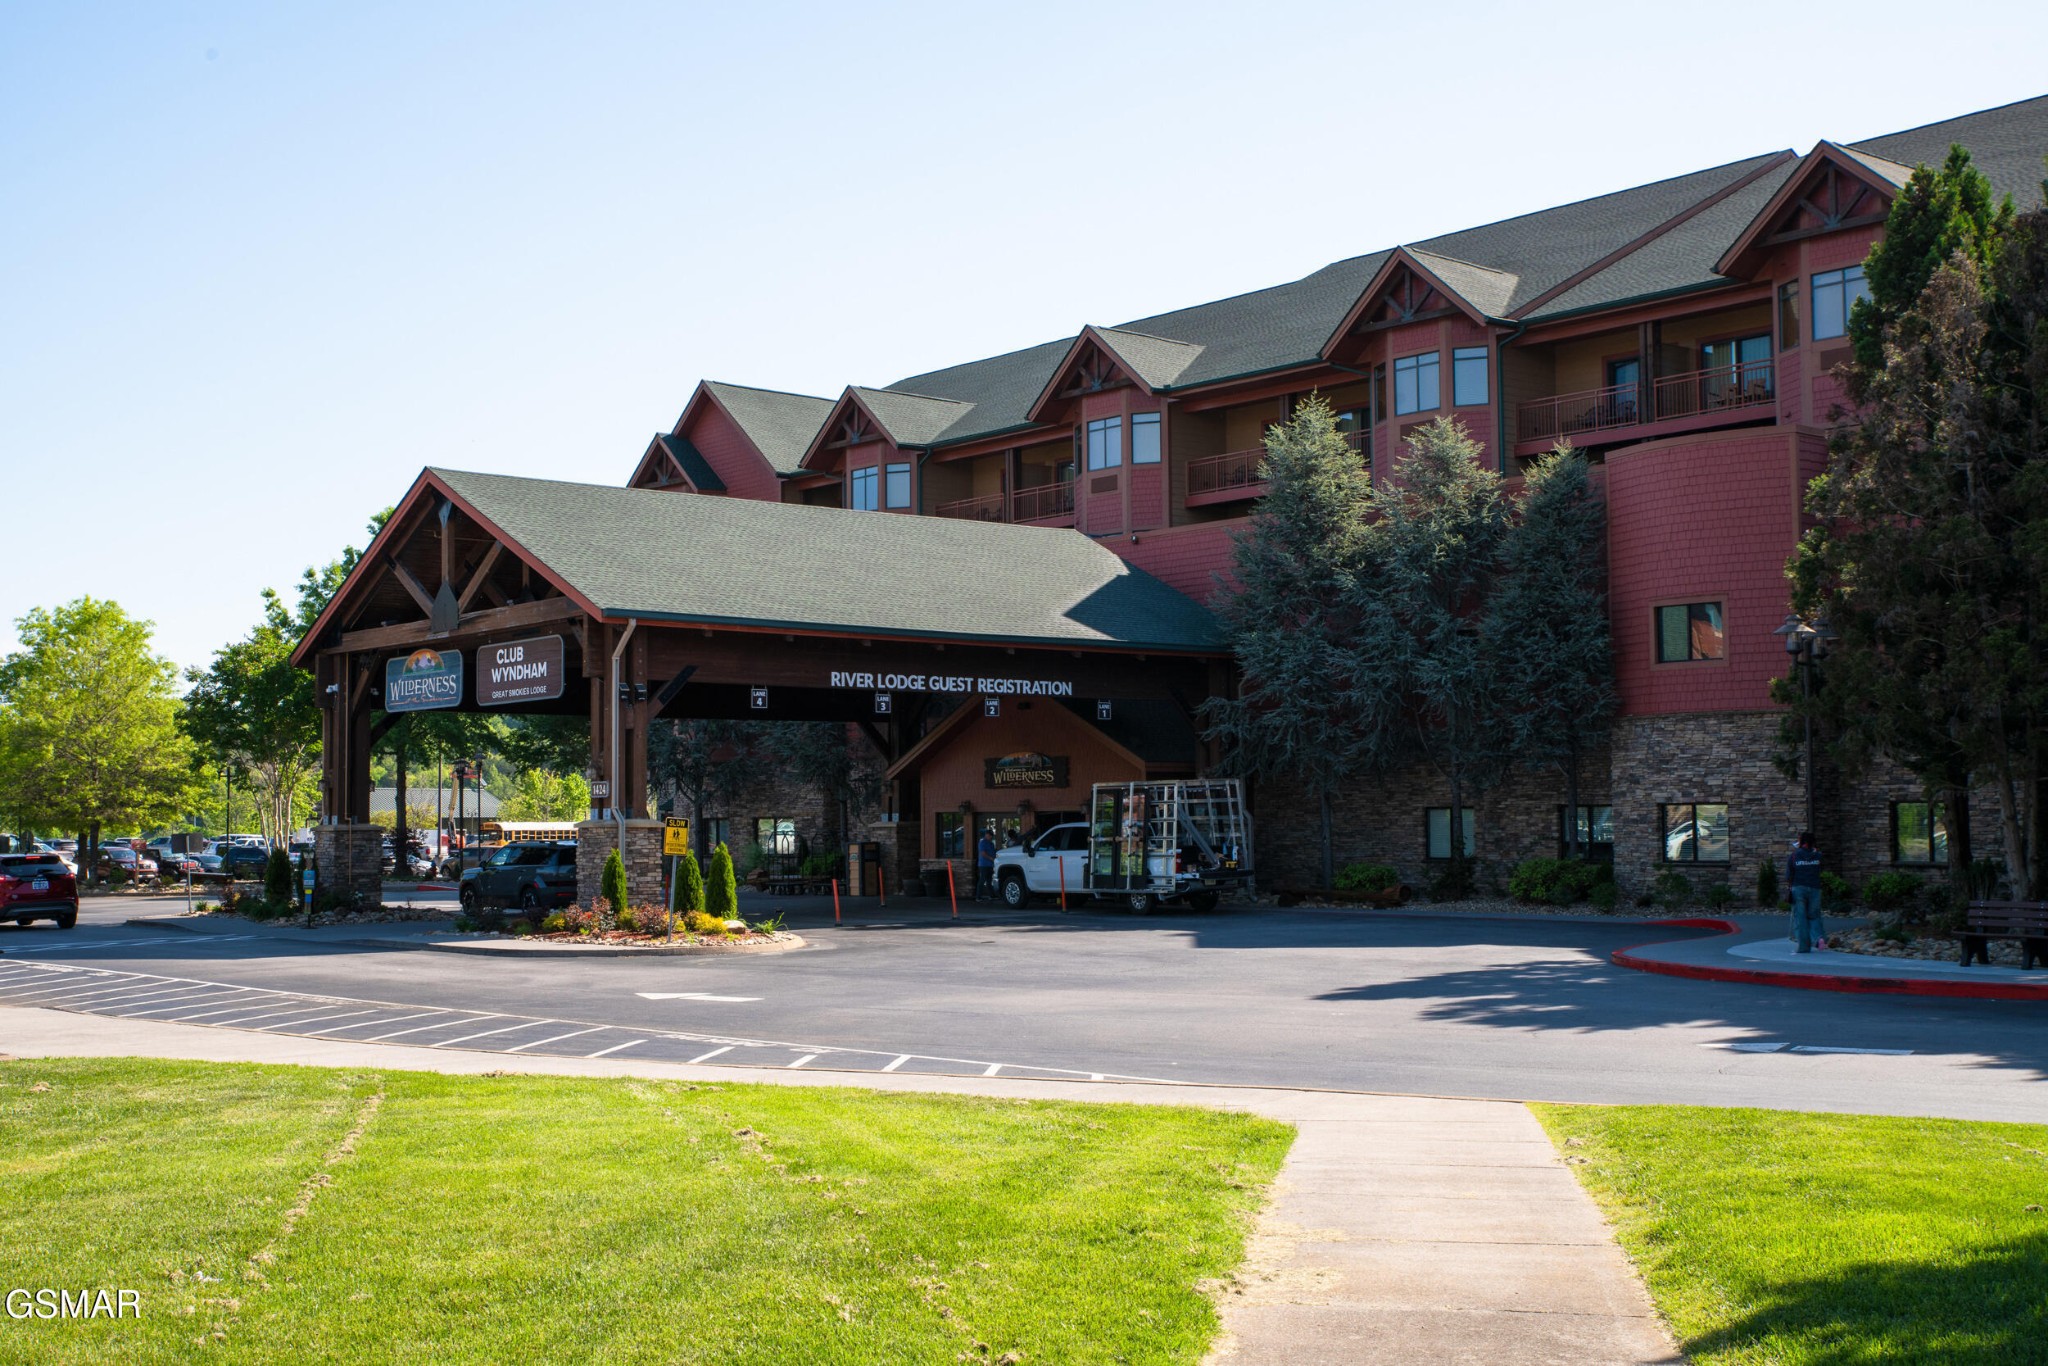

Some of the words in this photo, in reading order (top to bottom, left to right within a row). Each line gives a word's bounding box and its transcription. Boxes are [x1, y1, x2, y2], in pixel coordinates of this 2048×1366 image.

[497, 646, 524, 665] CLUB
[491, 661, 548, 683] WYNDHAM
[830, 671, 874, 688] RIVER
[878, 673, 926, 690] LODGE
[929, 675, 974, 692] GUEST
[978, 678, 1072, 696] REGISTRATION
[492, 689, 508, 699] GREAT
[508, 687, 530, 697] SMOKIES
[530, 685, 547, 695] LODGE
[756, 697, 763, 706] 4
[880, 702, 886, 711] 3
[989, 707, 995, 715] 2
[592, 784, 606, 795] 1424
